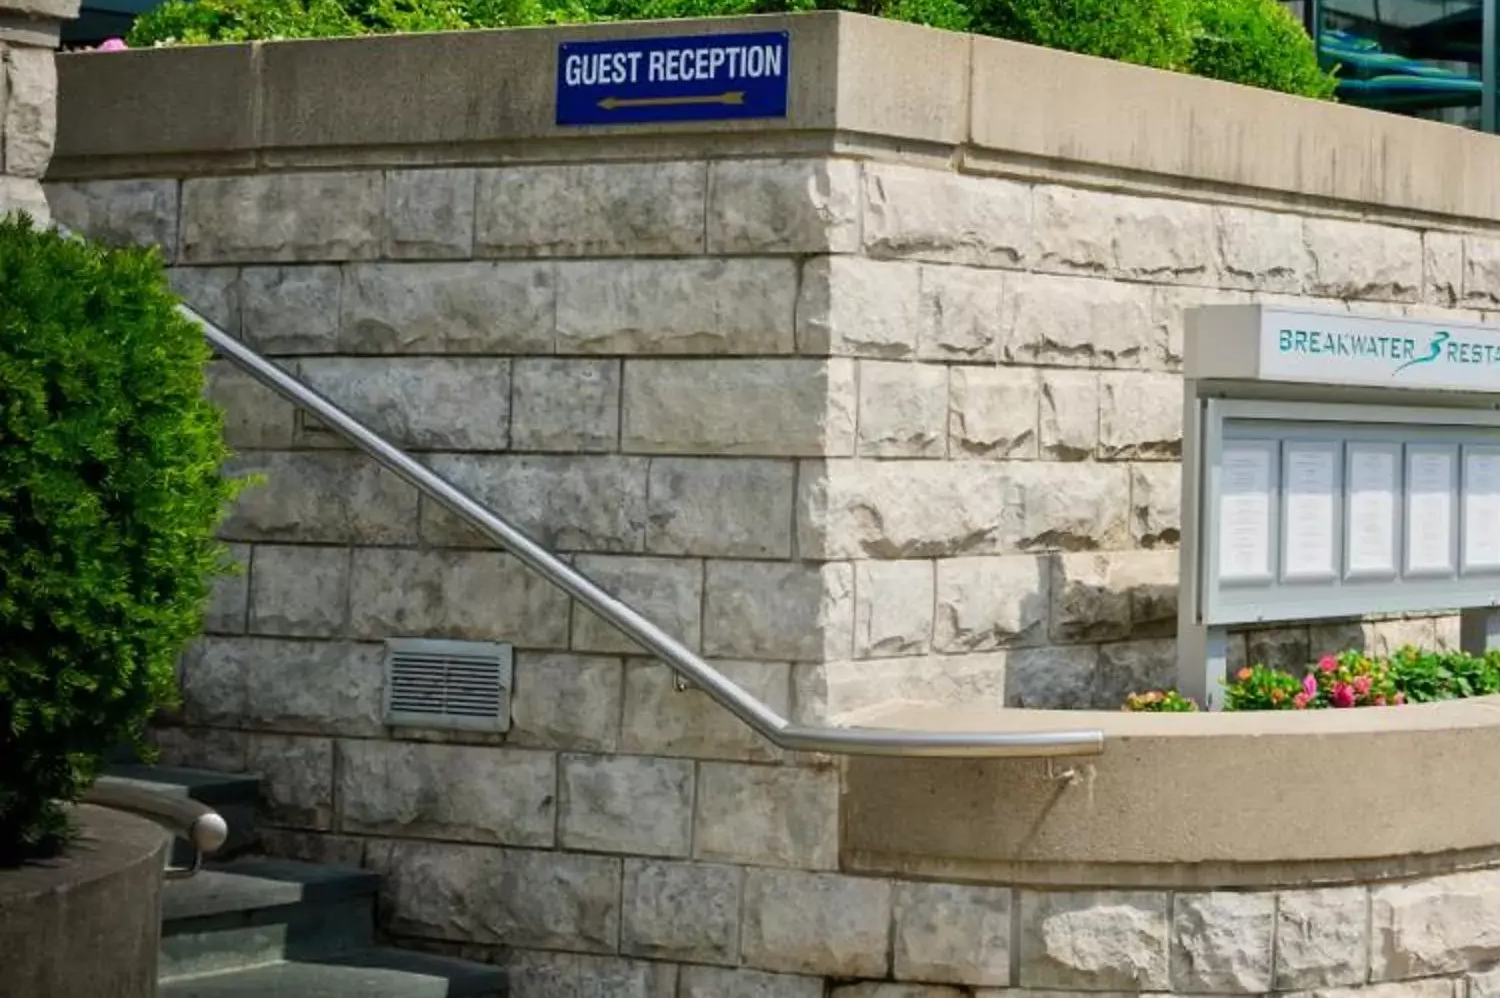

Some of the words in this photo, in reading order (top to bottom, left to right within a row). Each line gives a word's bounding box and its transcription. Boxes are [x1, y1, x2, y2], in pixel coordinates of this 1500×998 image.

[565, 52, 642, 86] GUEST
[648, 44, 782, 82] RECEPTION
[1279, 329, 1415, 360] BREAKWATER
